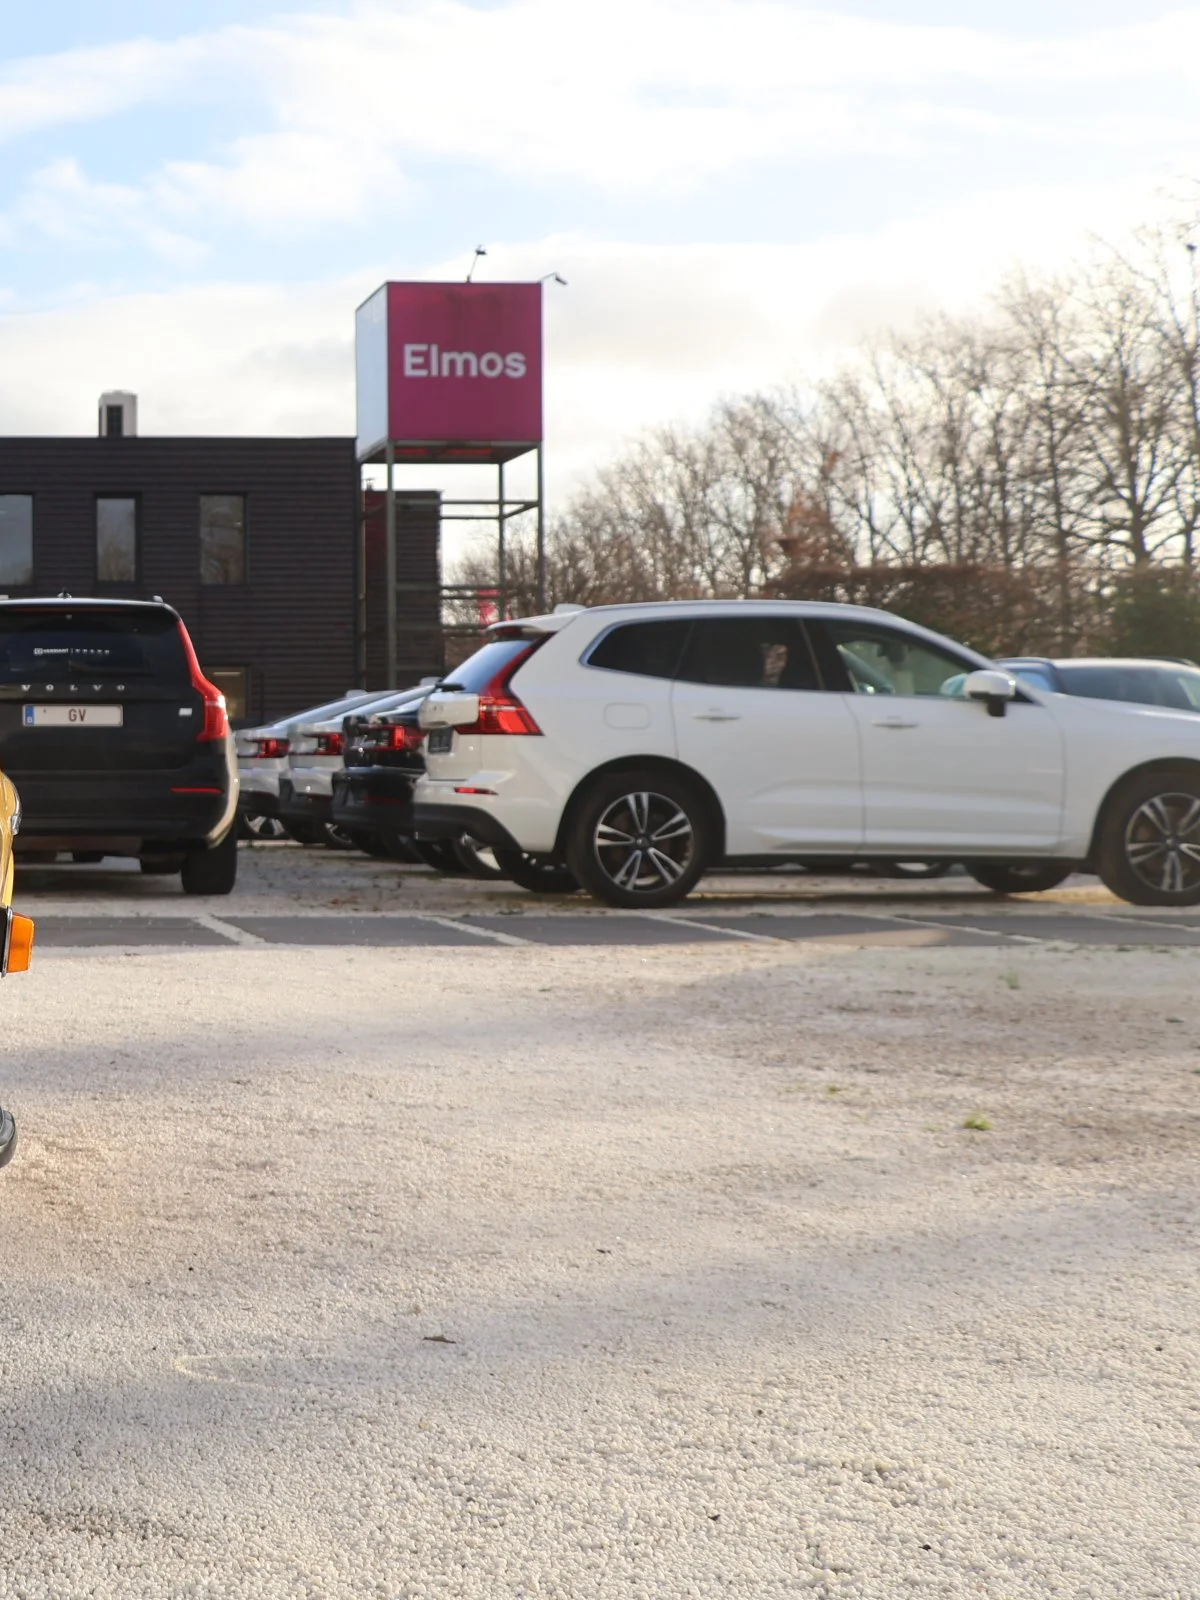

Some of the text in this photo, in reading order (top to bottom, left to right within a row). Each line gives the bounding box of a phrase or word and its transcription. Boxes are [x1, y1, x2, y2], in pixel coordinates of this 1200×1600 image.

[403, 343, 527, 379] Elmos
[21, 684, 125, 692] VOLVO
[68, 708, 87, 722] GV
